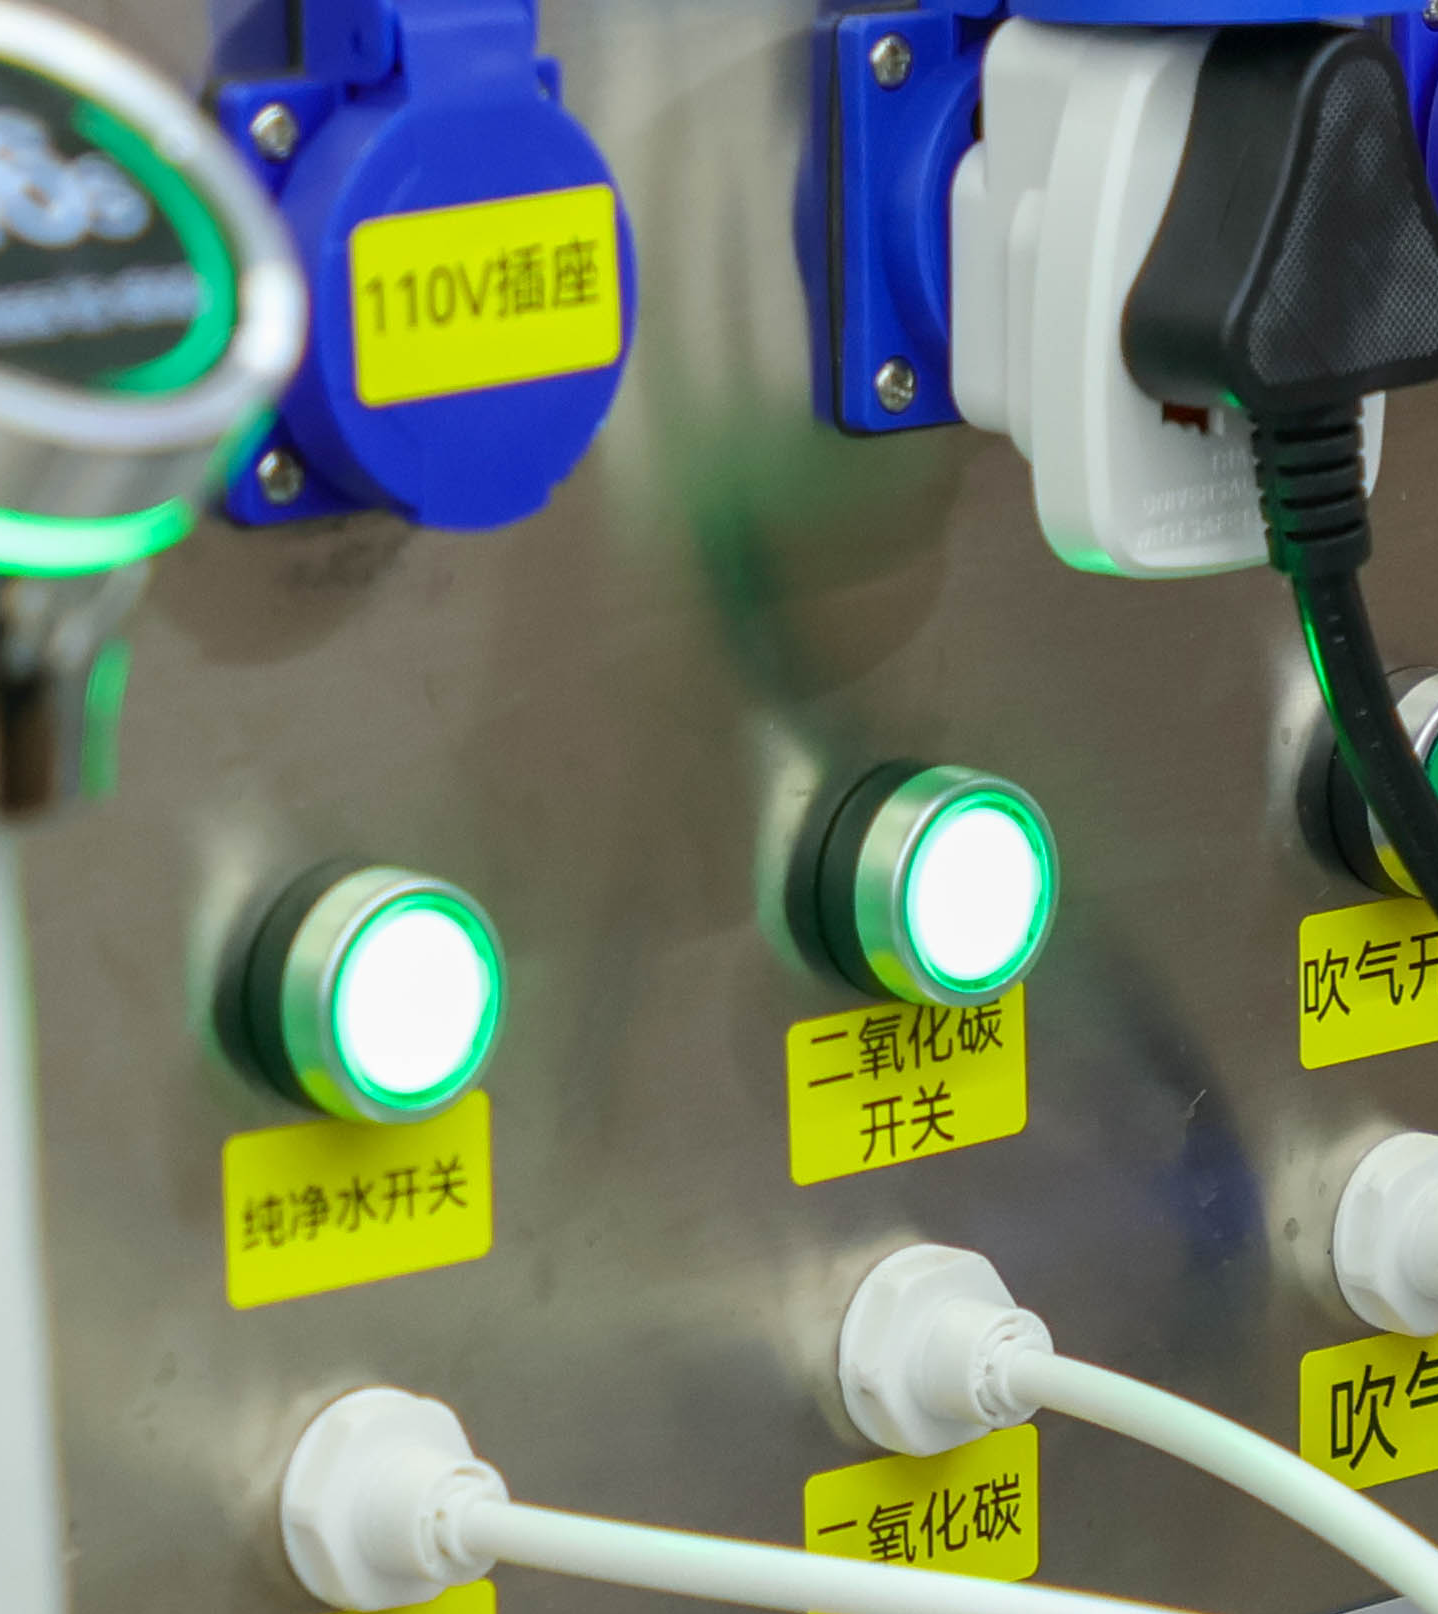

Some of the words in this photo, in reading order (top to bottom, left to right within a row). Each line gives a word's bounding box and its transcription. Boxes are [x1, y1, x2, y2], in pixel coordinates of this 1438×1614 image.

[362, 236, 601, 334] 110V插座
[860, 1081, 955, 1163] 开关
[242, 1153, 468, 1253] 纯净水开关
